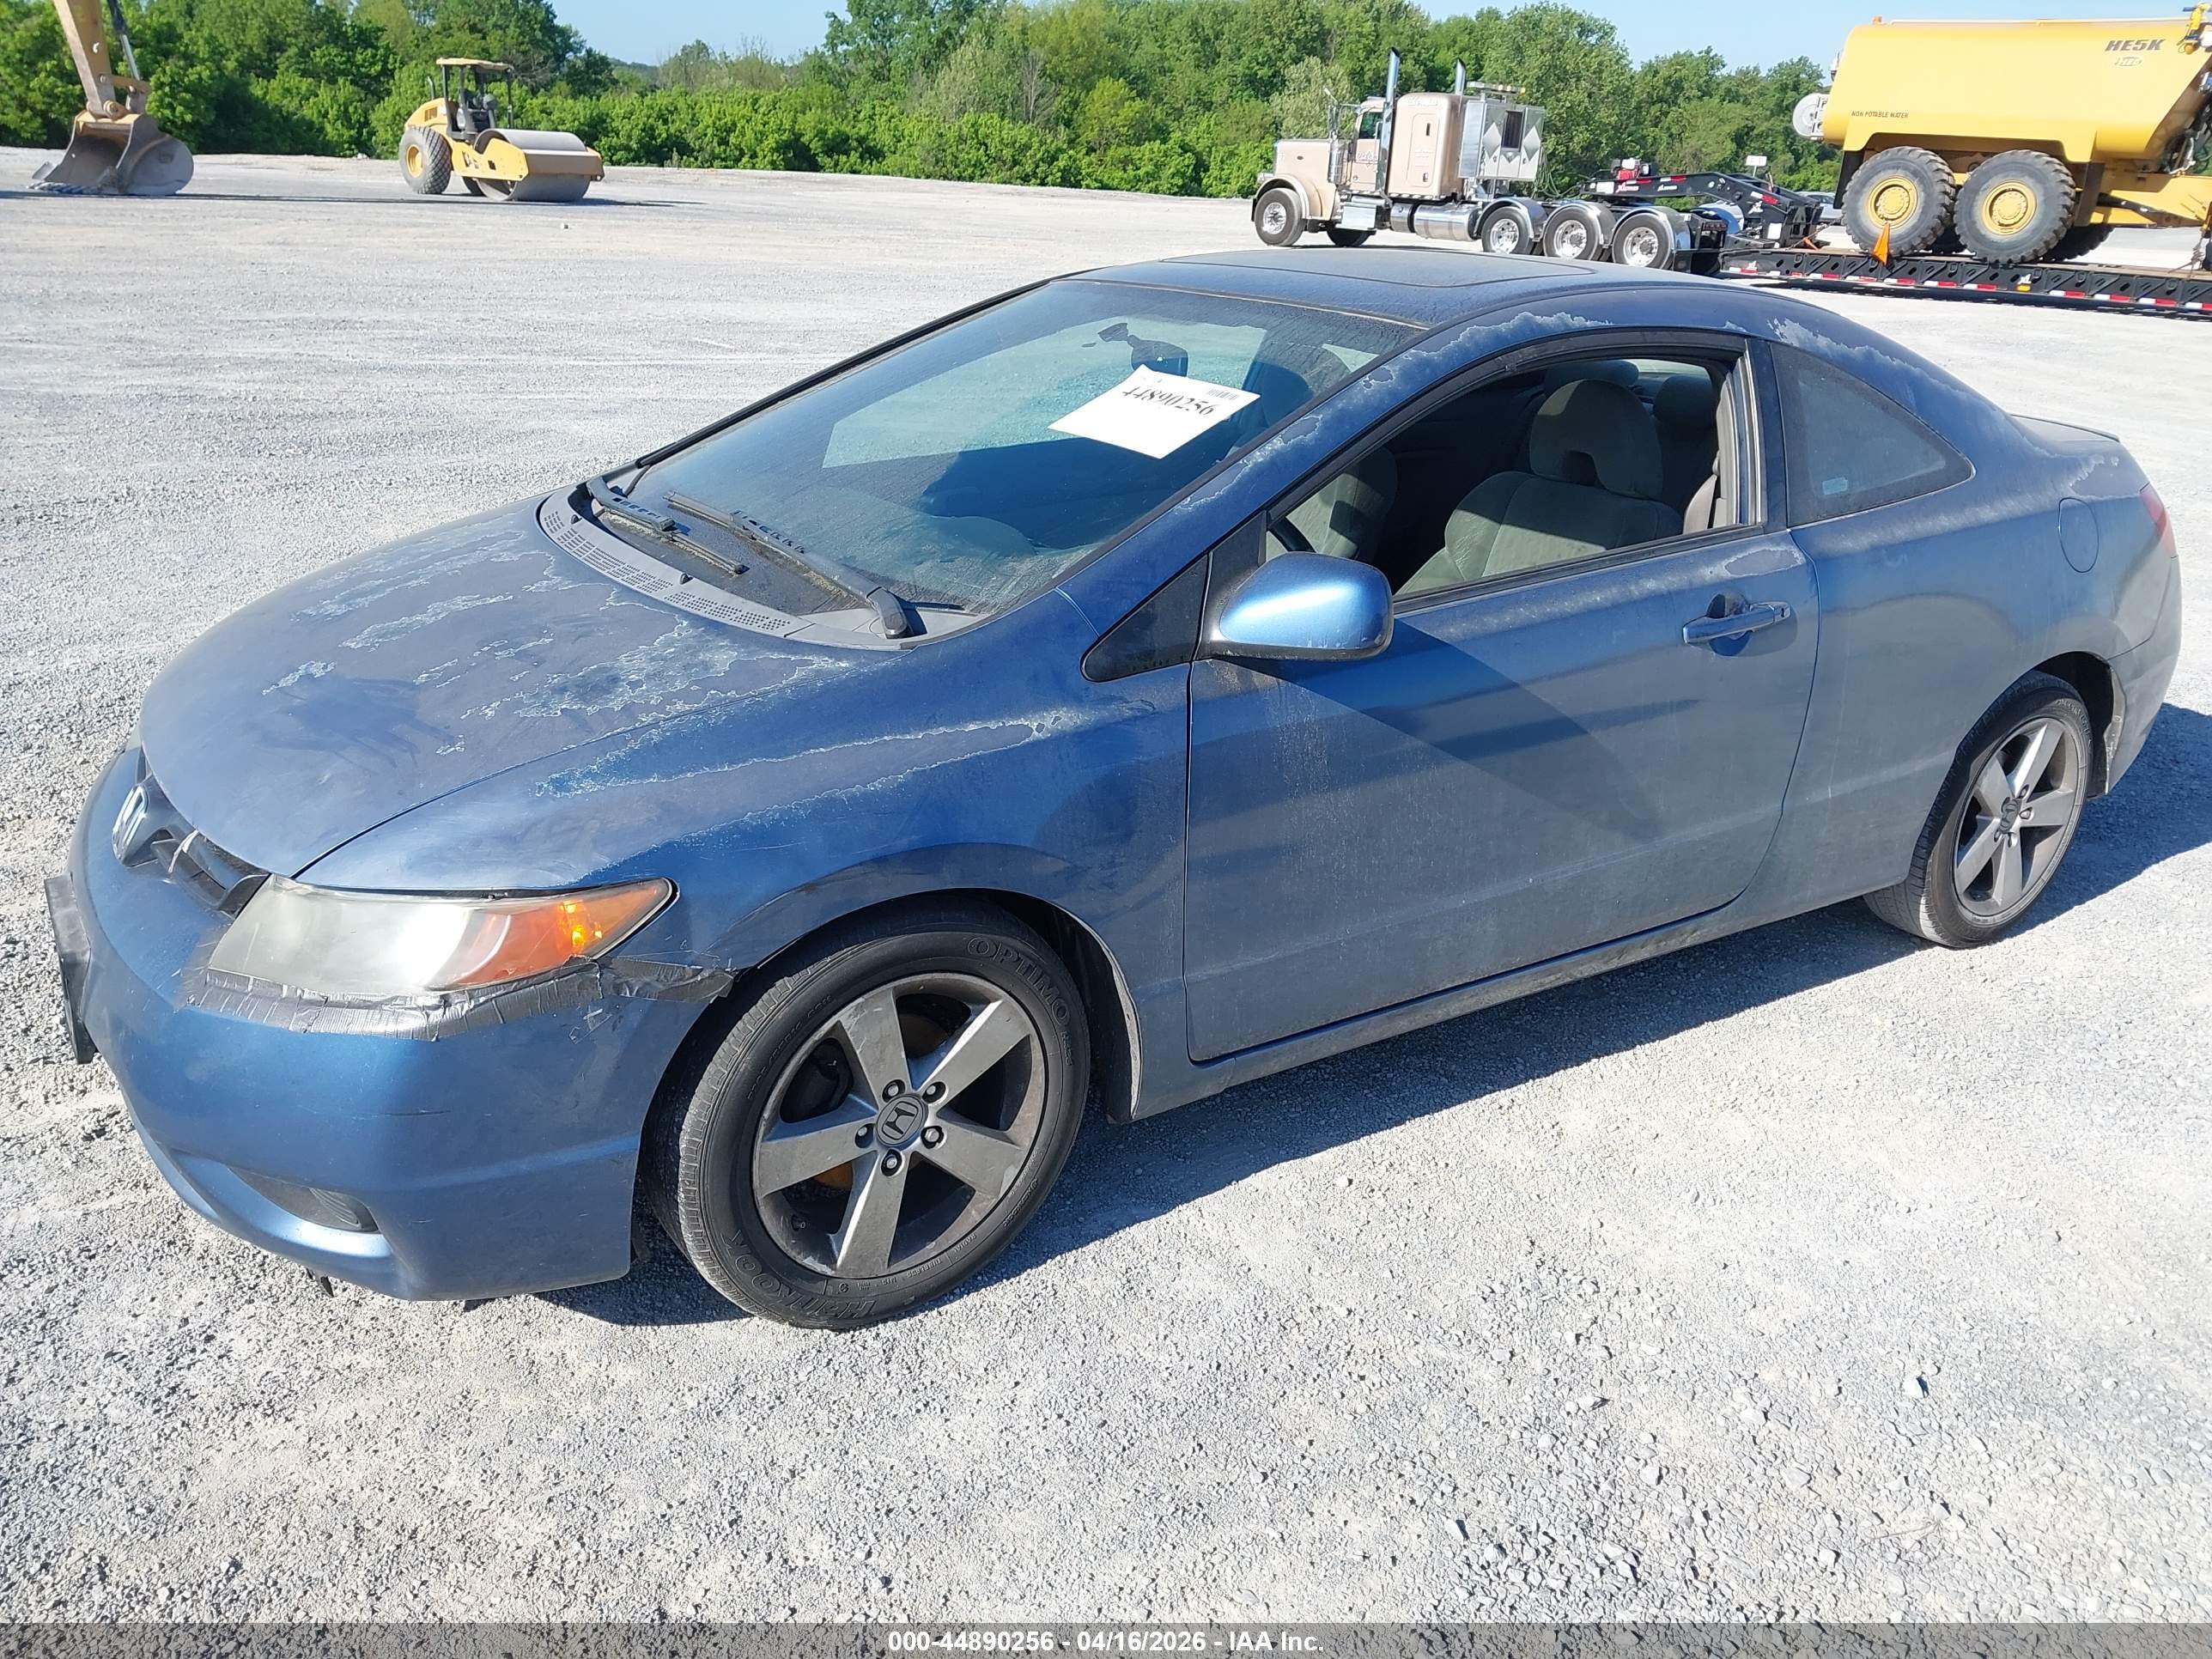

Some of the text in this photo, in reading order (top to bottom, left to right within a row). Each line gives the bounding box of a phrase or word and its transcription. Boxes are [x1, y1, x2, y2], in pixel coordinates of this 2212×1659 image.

[2105, 39, 2166, 52] HE5K
[1121, 386, 1216, 415] 44890256
[968, 937, 1071, 1024] OPTIMO
